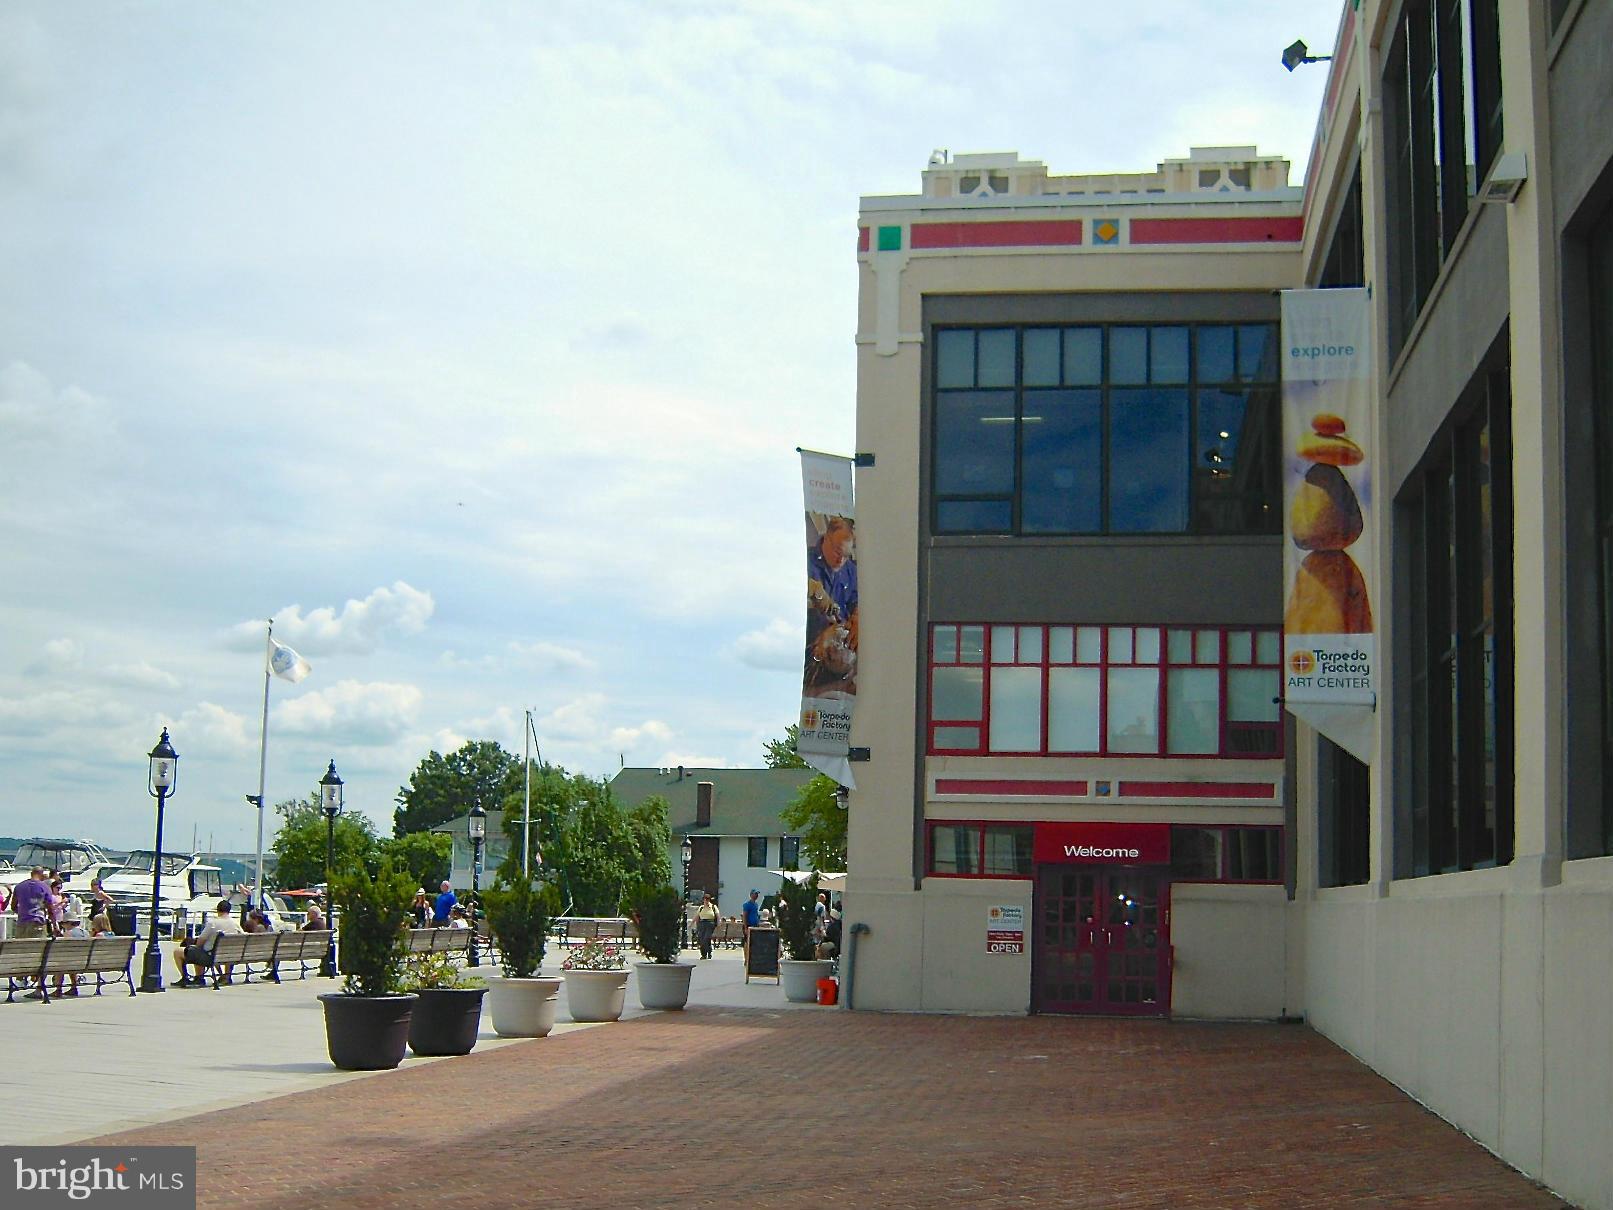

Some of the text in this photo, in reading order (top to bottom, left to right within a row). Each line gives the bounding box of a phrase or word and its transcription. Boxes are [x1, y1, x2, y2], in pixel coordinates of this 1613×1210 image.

[1291, 344, 1355, 359] explore
[809, 480, 841, 491] create
[1313, 649, 1367, 663] Torpedo
[1322, 662, 1370, 676] Factory
[1288, 677, 1370, 689] ART CENTER
[817, 710, 850, 722] Torpedo
[822, 720, 850, 732] Factory
[800, 730, 849, 741] ART CENTER
[1063, 845, 1139, 858] Welcome
[991, 943, 1019, 953] OPEN
